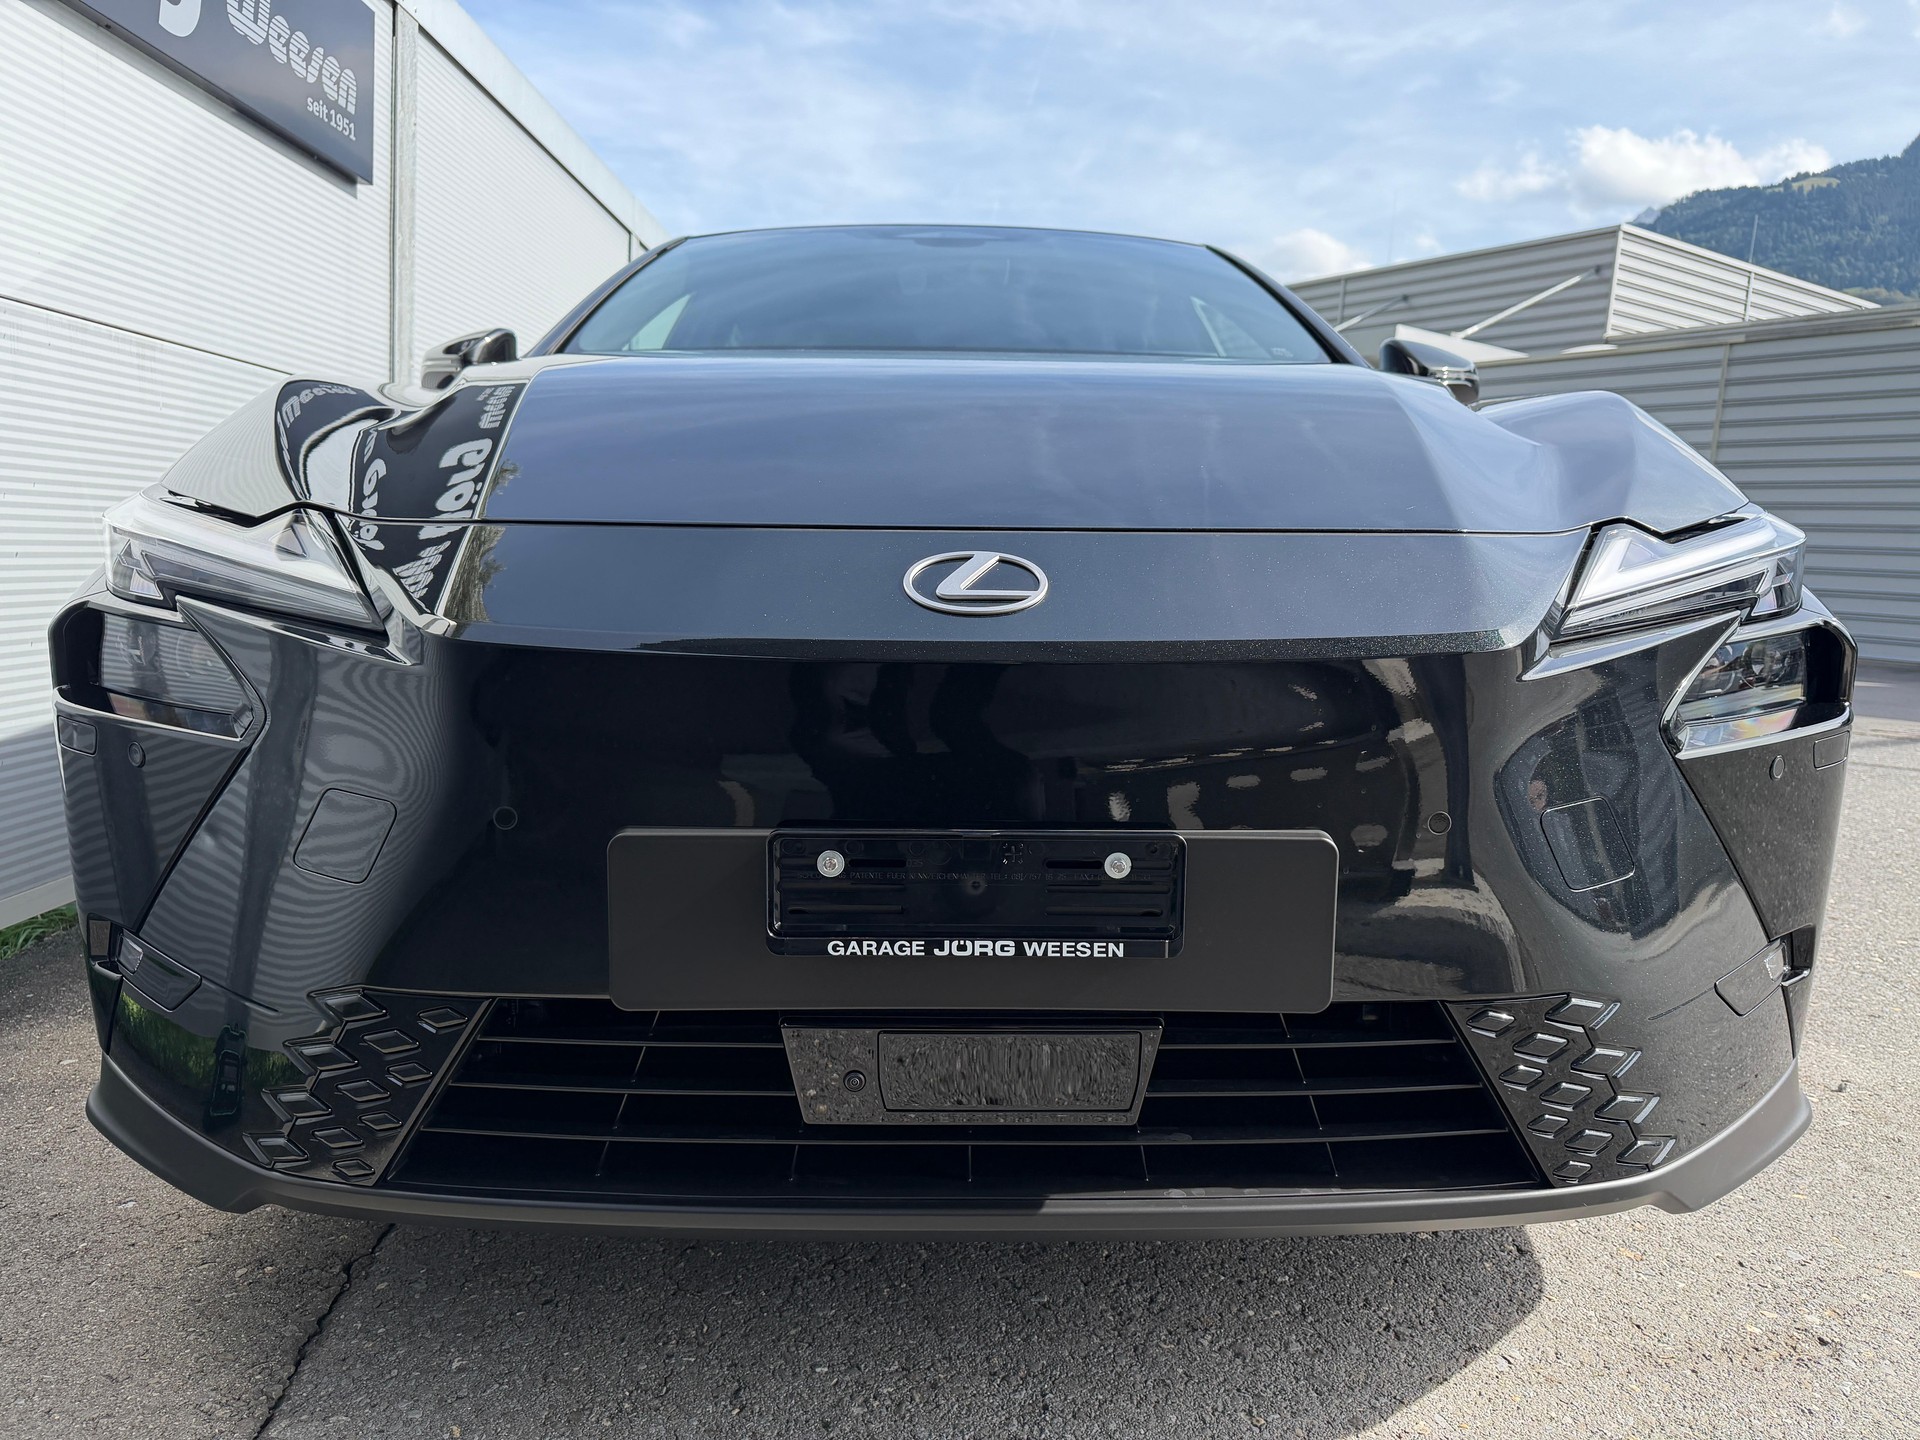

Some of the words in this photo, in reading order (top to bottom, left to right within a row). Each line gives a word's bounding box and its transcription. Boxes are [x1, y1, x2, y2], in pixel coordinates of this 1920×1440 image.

[226, 0, 357, 115] Weesen
[306, 97, 328, 122] seit
[329, 109, 356, 141] 1951
[827, 940, 925, 956] GARAGE
[933, 940, 1016, 957] JÖRG
[1023, 941, 1124, 957] WEESEN
